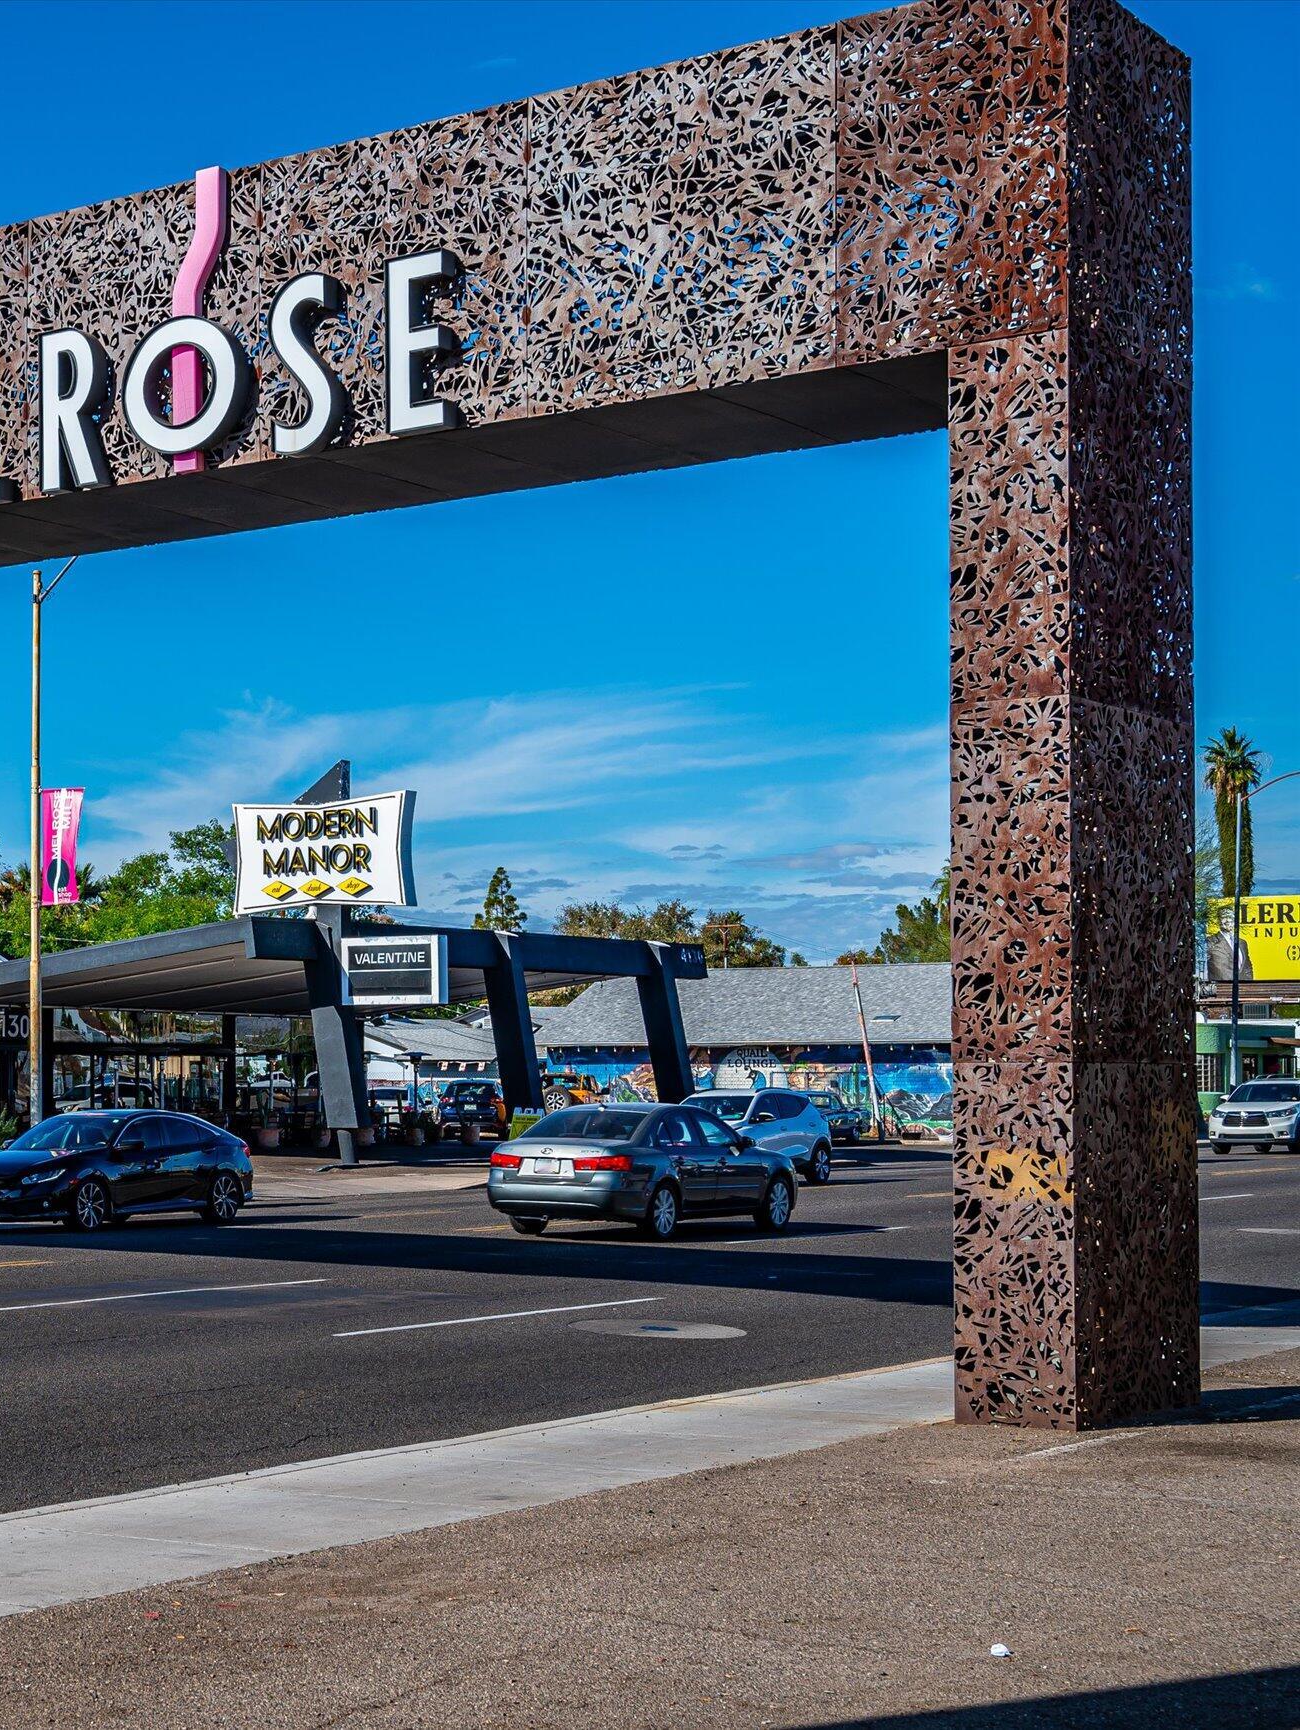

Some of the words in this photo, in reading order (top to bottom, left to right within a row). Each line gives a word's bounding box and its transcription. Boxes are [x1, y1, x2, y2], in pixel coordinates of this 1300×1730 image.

[62, 789, 75, 830] MILE
[51, 790, 61, 860] MELROSE
[257, 807, 378, 843] MODERN
[263, 844, 372, 877] MANOR
[1240, 903, 1300, 924] LER
[355, 951, 425, 964] VALENTINE
[727, 1058, 776, 1068] LOUNGE
[736, 1049, 768, 1059] QUAIL
